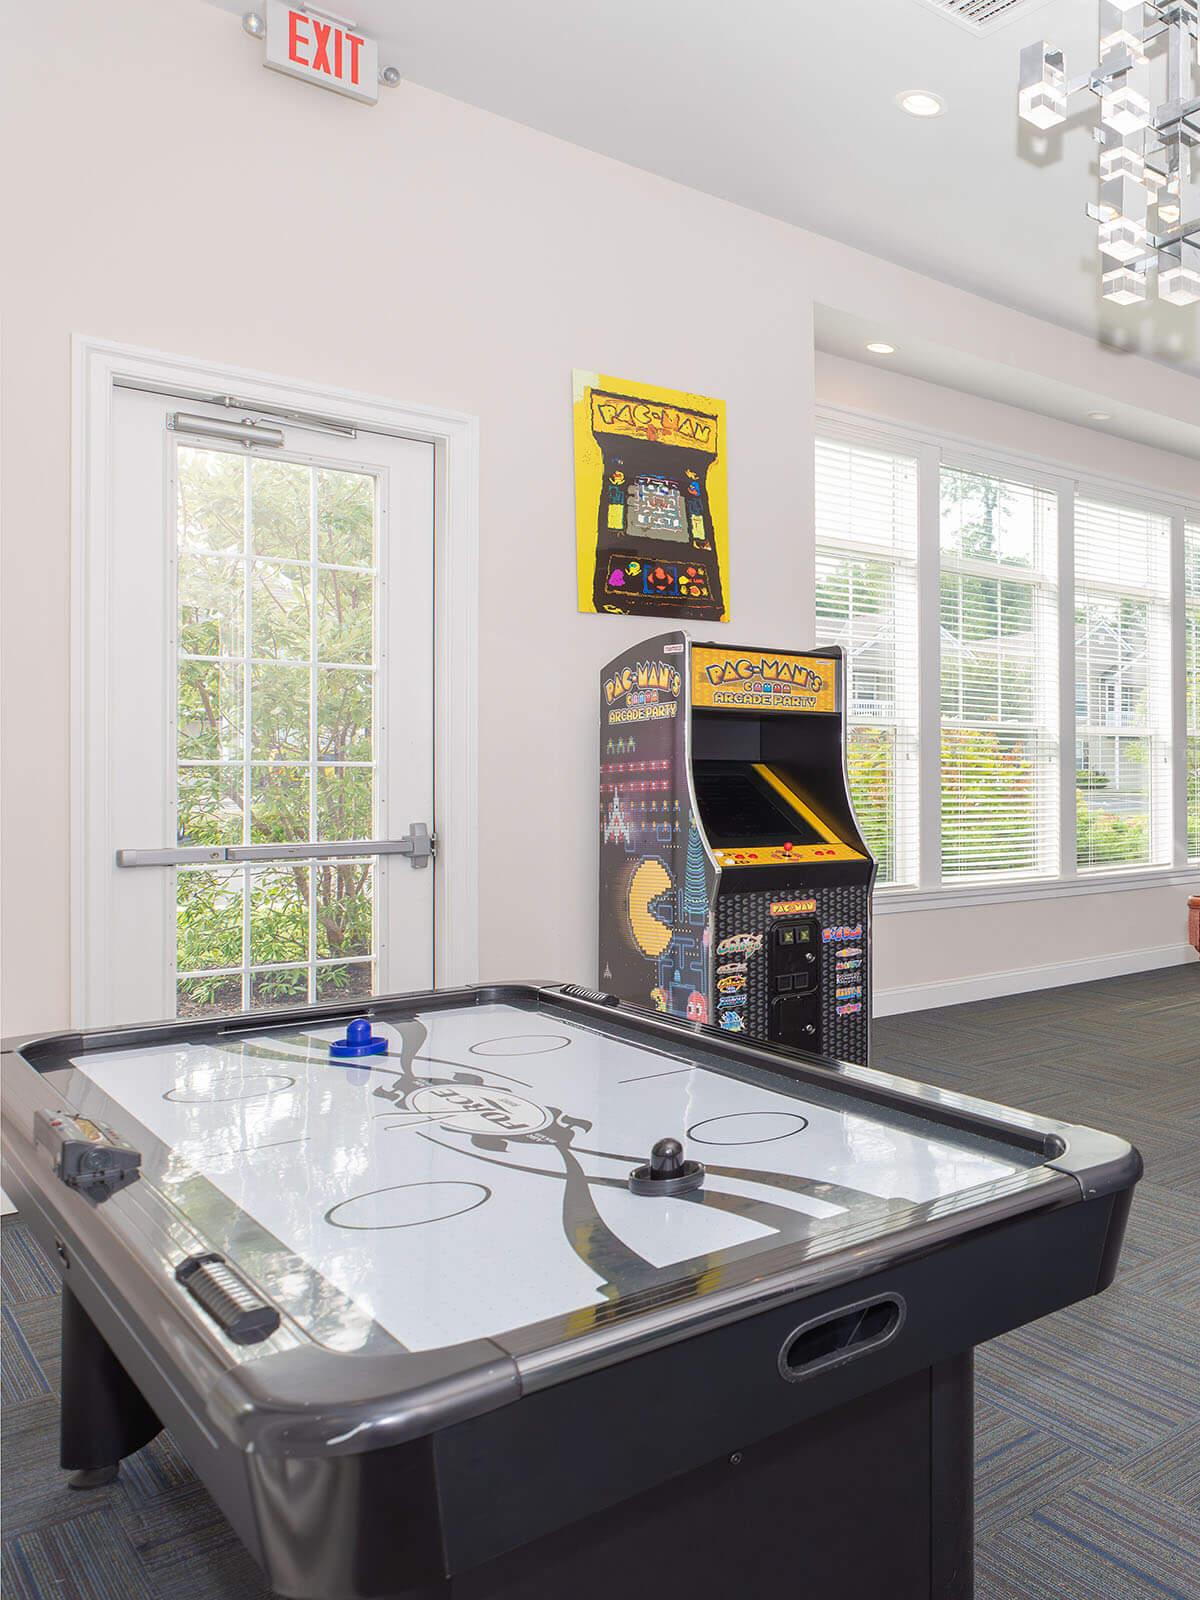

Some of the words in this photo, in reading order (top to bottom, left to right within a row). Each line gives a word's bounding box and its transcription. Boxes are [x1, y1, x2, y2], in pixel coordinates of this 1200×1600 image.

[288, 10, 364, 85] EXIT
[597, 402, 711, 443] PAC-MAN
[706, 658, 823, 693] PAC-MAN'S
[608, 707, 645, 725] ARCADE
[645, 702, 678, 719] PARTY
[713, 692, 771, 705] ARCADE
[773, 695, 817, 708] PARTY
[430, 1088, 529, 1129] FORCE
